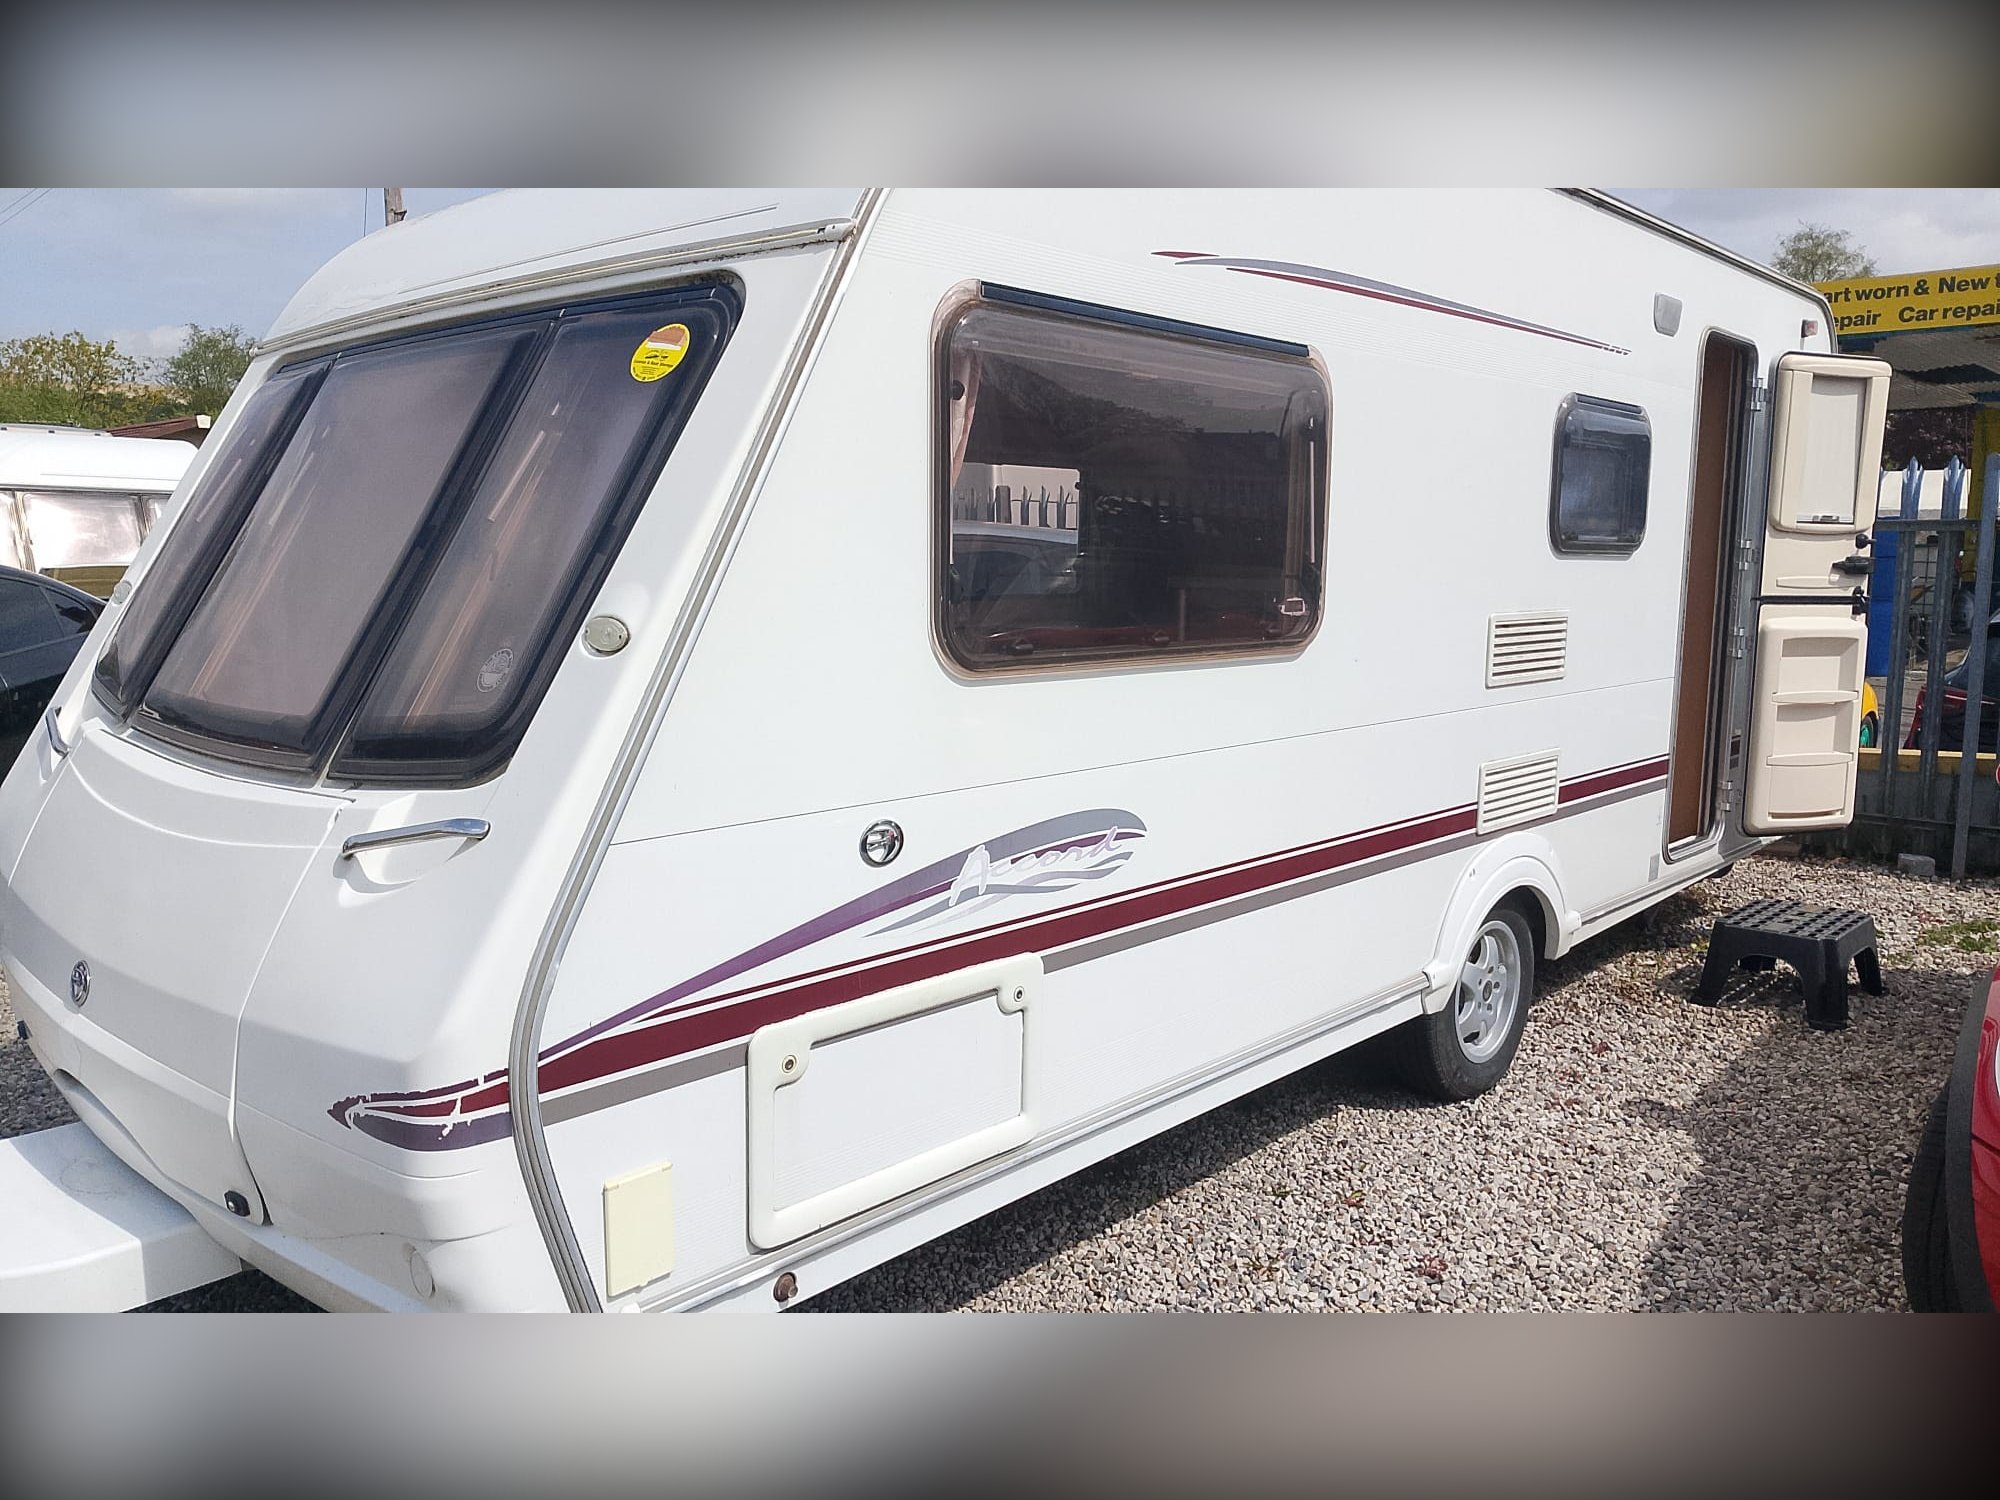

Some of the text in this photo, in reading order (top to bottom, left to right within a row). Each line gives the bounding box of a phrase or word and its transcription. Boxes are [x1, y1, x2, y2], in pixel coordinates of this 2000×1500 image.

[1855, 285, 1909, 301] worn
[1913, 279, 1929, 296] &
[1938, 275, 1991, 293] New
[1898, 306, 1938, 323] Car
[949, 825, 1122, 907] Accord
